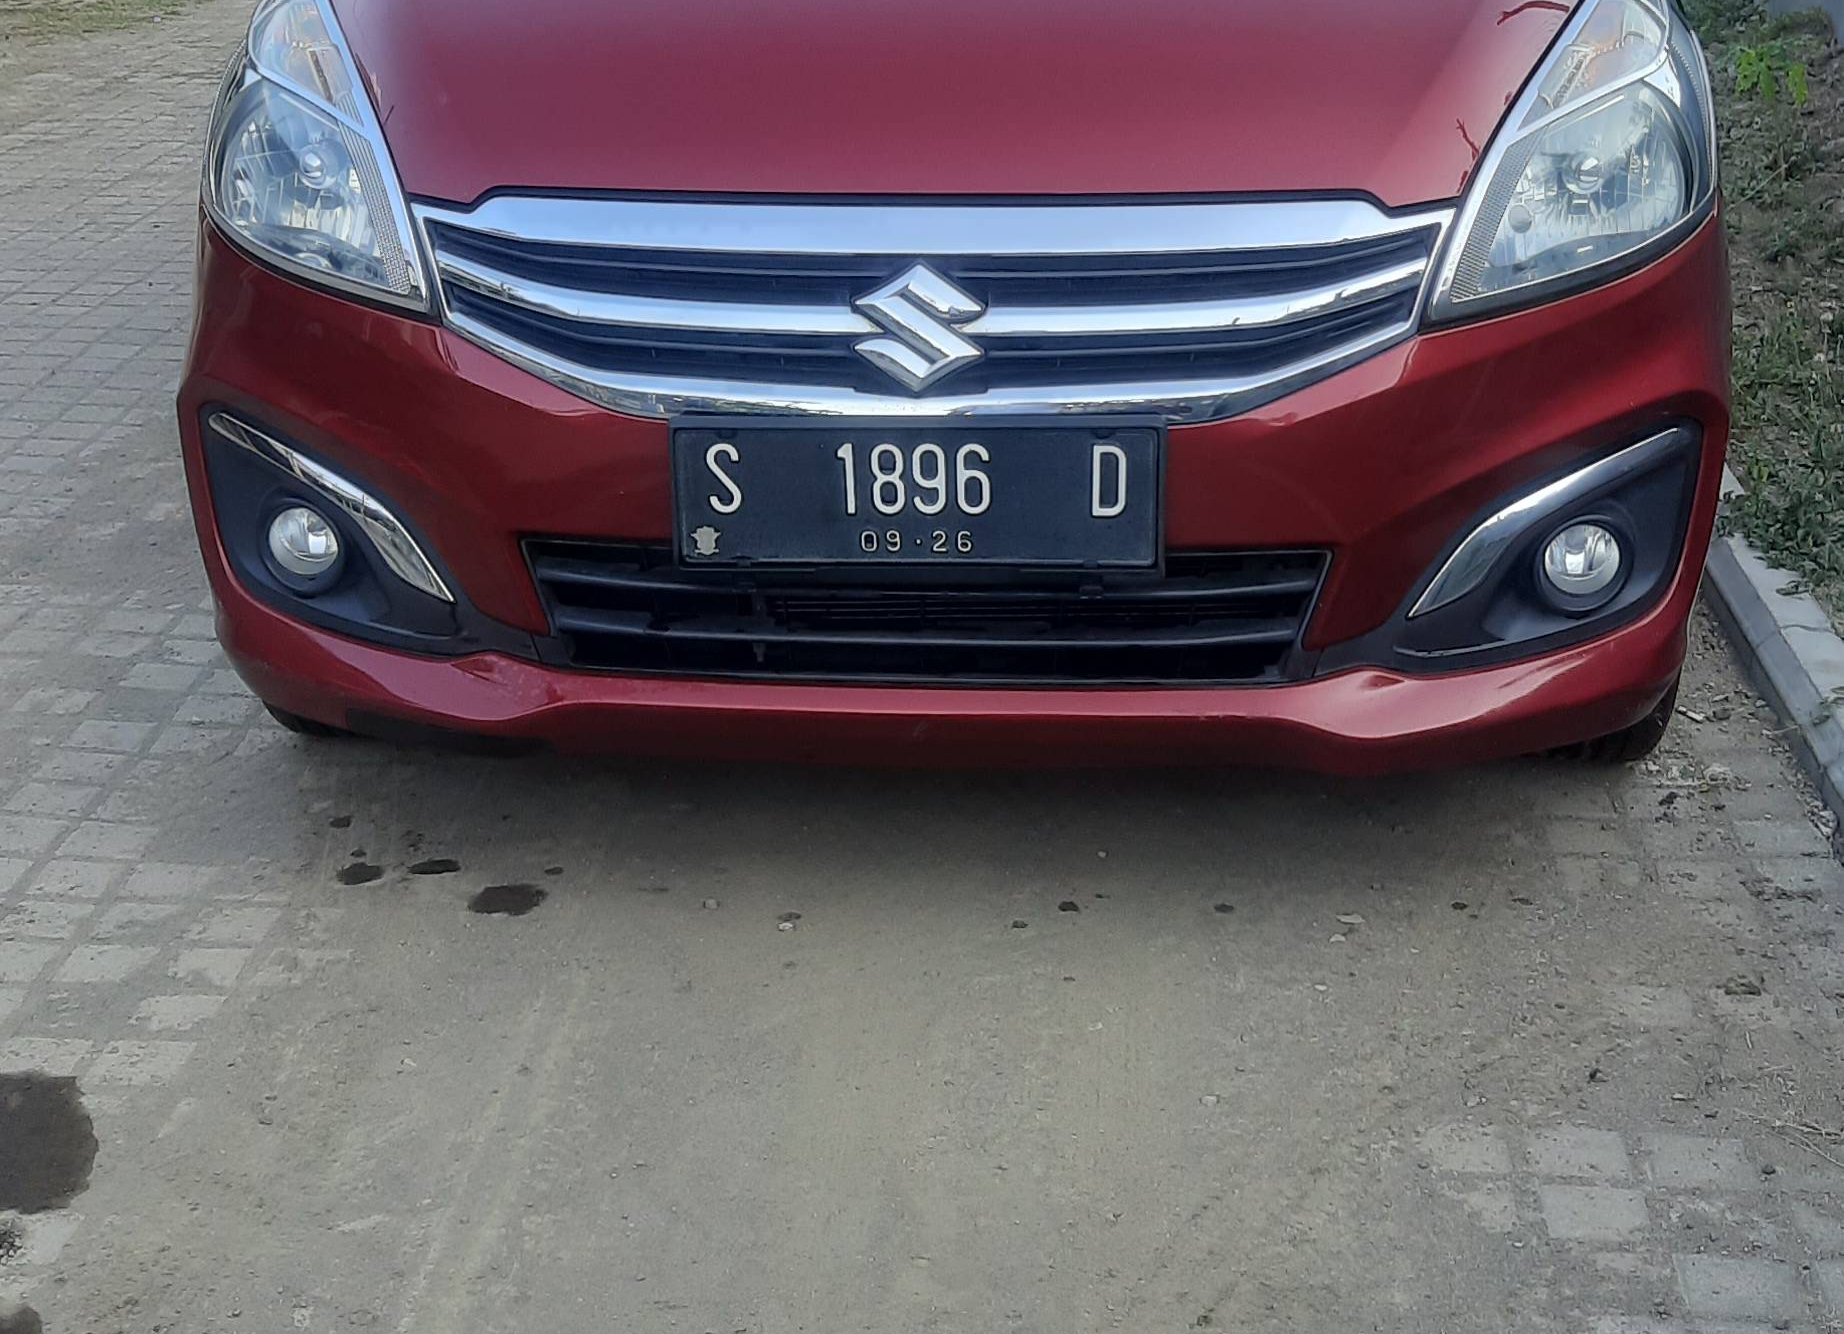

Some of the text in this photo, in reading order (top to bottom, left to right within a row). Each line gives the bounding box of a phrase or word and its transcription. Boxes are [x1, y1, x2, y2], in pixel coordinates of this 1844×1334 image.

[706, 443, 1127, 517] S 1896 D
